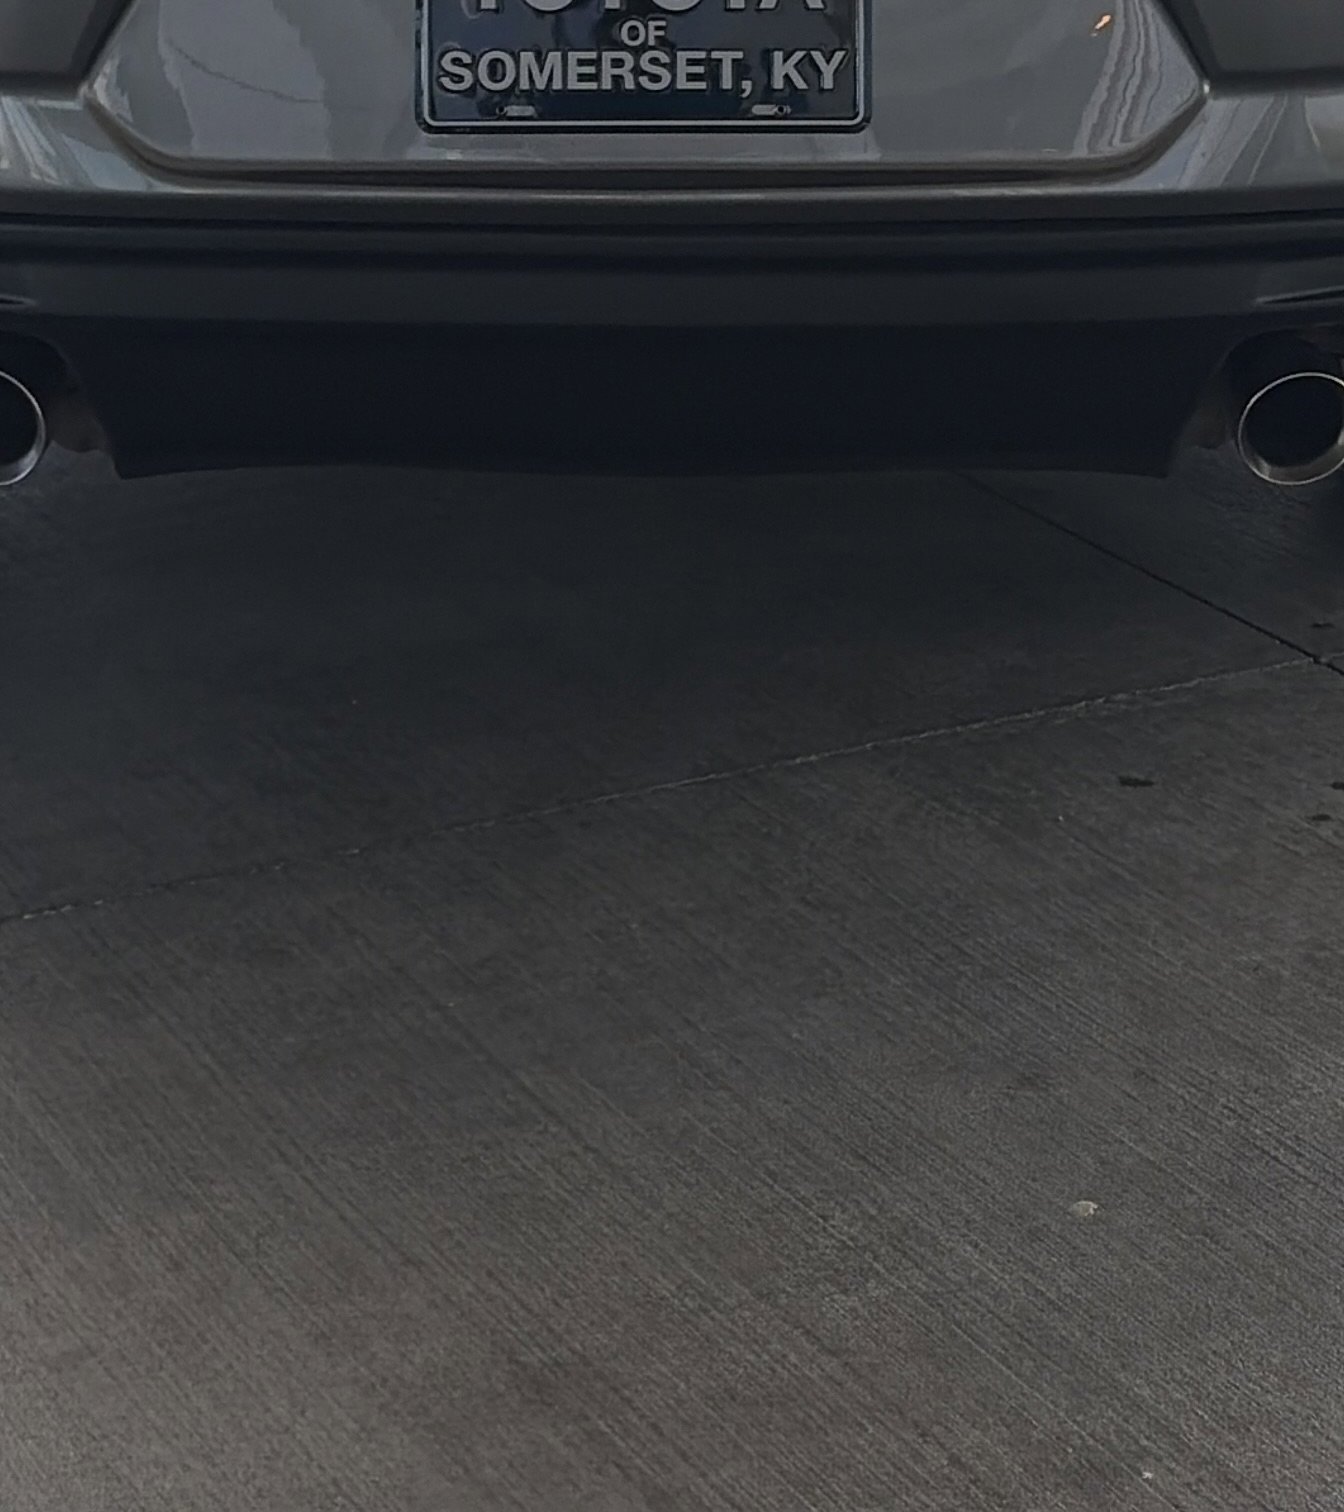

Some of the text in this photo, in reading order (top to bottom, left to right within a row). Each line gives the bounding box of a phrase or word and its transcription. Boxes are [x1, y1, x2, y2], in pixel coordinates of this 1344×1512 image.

[620, 20, 666, 47] OF
[439, 50, 848, 97] SOMERSET, KY
